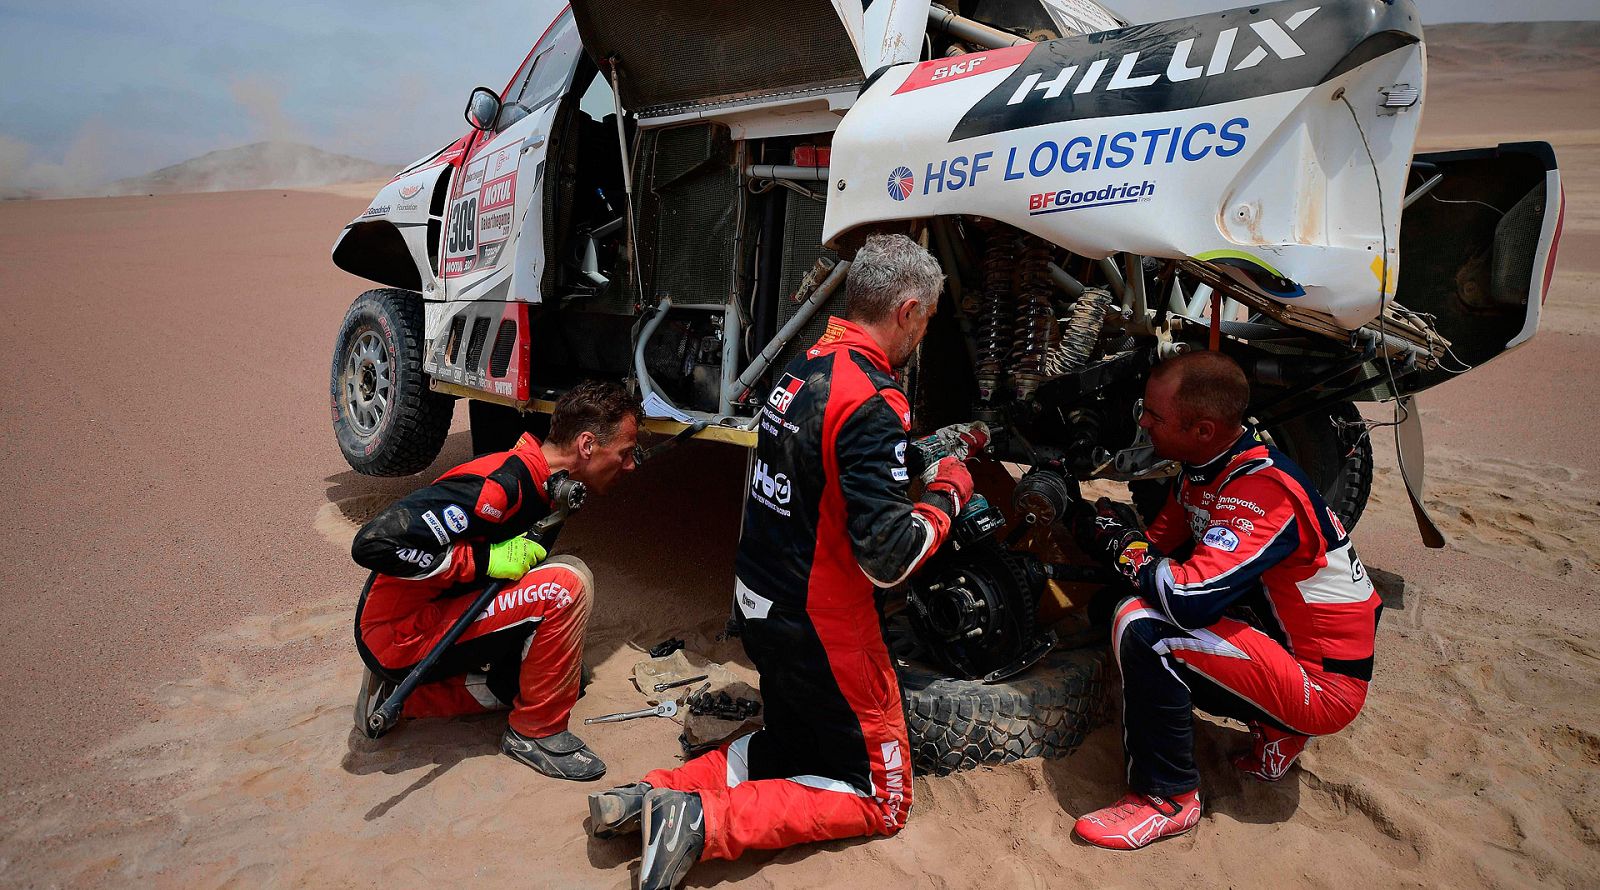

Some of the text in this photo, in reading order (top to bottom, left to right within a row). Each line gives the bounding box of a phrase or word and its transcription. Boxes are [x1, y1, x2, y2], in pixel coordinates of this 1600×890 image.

[930, 57, 988, 81] SKF
[1006, 6, 1322, 106] HILUX
[922, 117, 1250, 196] HSF LOGISTICS
[483, 180, 511, 207] MOTUL
[1029, 181, 1155, 210] BFGoodrich
[449, 197, 476, 253] 309
[769, 386, 794, 412] GR
[1219, 495, 1266, 517] Innovation
